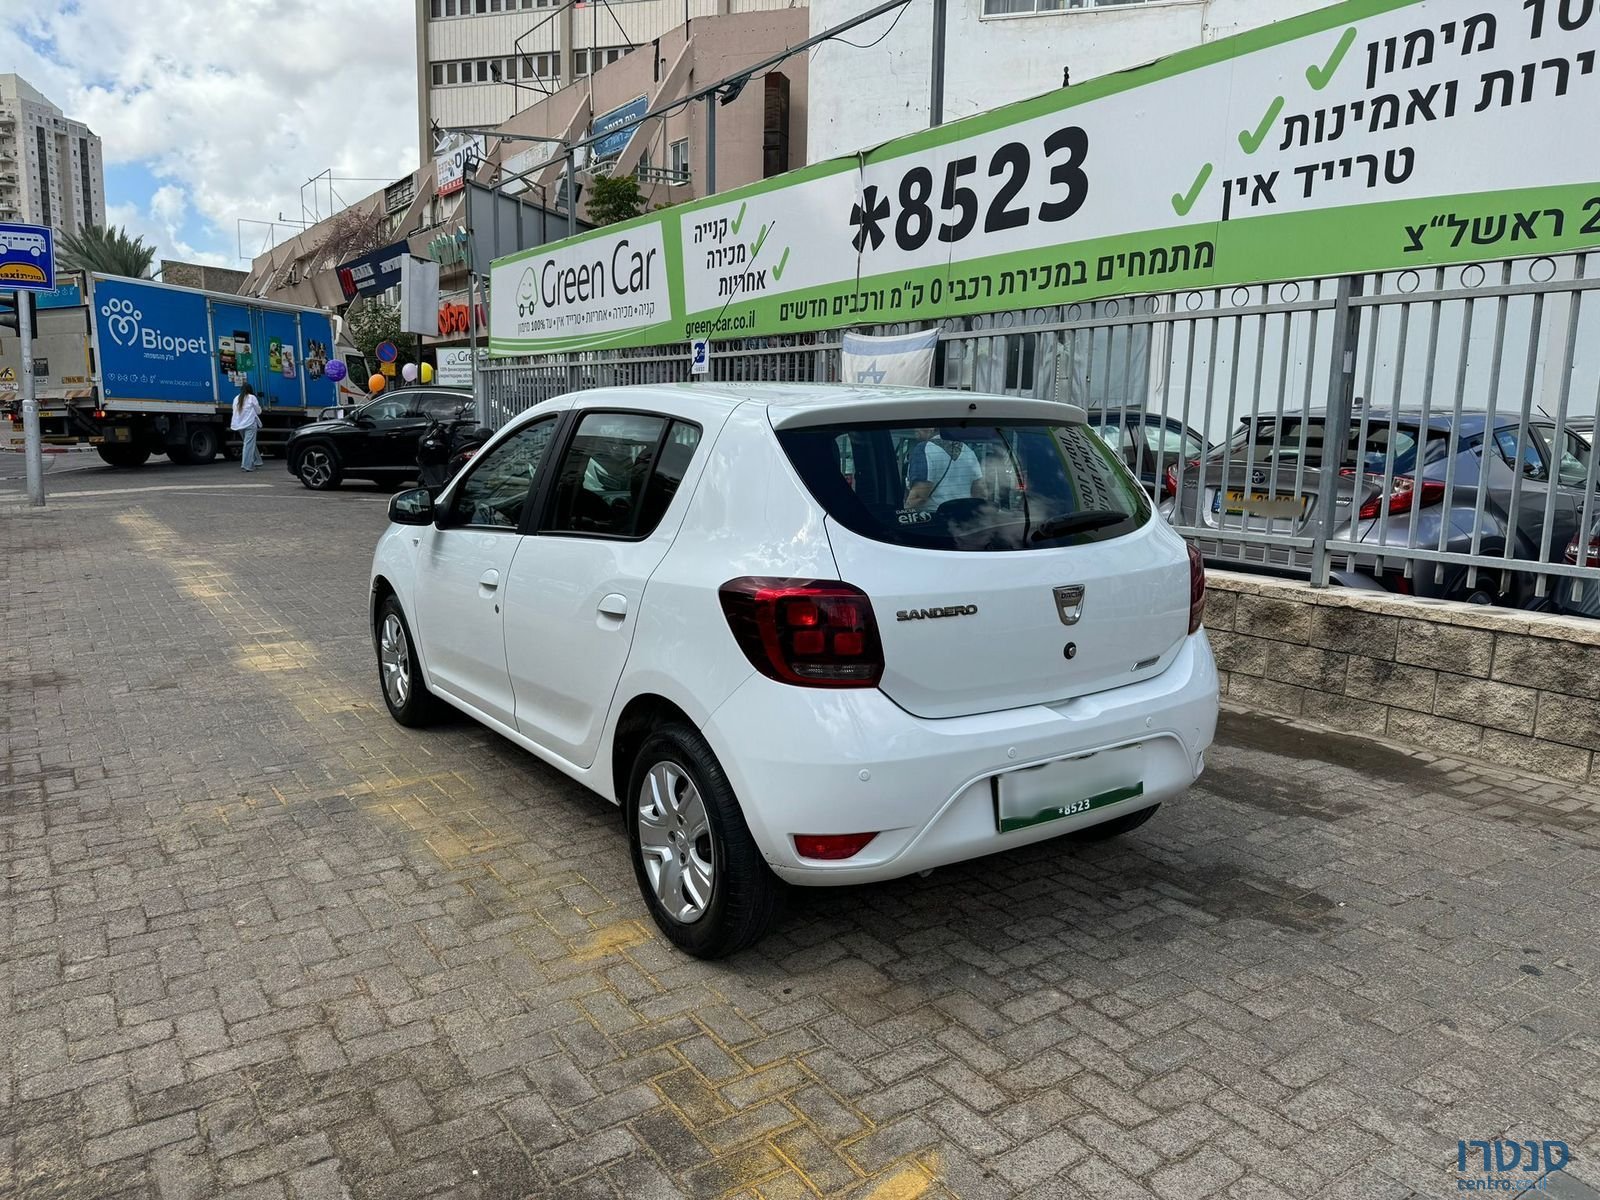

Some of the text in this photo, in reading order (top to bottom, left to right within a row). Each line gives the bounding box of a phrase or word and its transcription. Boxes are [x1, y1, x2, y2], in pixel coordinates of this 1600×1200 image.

[1366, 0, 1600, 89] 10 מימון
[1279, 50, 1596, 151] ירות ואמינות
[1222, 146, 1415, 221] טרייד אין
[694, 218, 728, 244] קנייה
[706, 243, 746, 269] מכירה
[1097, 241, 1215, 282] מתמחים
[0, 268, 19, 278] taxi
[541, 239, 656, 308] Green Car
[718, 270, 767, 296] אחריות
[999, 259, 1087, 295] במכירת
[931, 278, 942, 304] 0
[949, 275, 991, 302] רכבי
[585, 309, 608, 323] אחריות
[612, 305, 633, 318] מכירה
[638, 302, 655, 319] קניה
[779, 299, 827, 321] חדשים
[833, 291, 883, 315] ורכבים
[531, 320, 546, 331] 100%
[556, 316, 565, 330] אין
[566, 313, 581, 325] טרייד
[685, 310, 756, 338] green-car.co.il
[142, 327, 208, 357] Biopet
[896, 604, 978, 622] SANDERO
